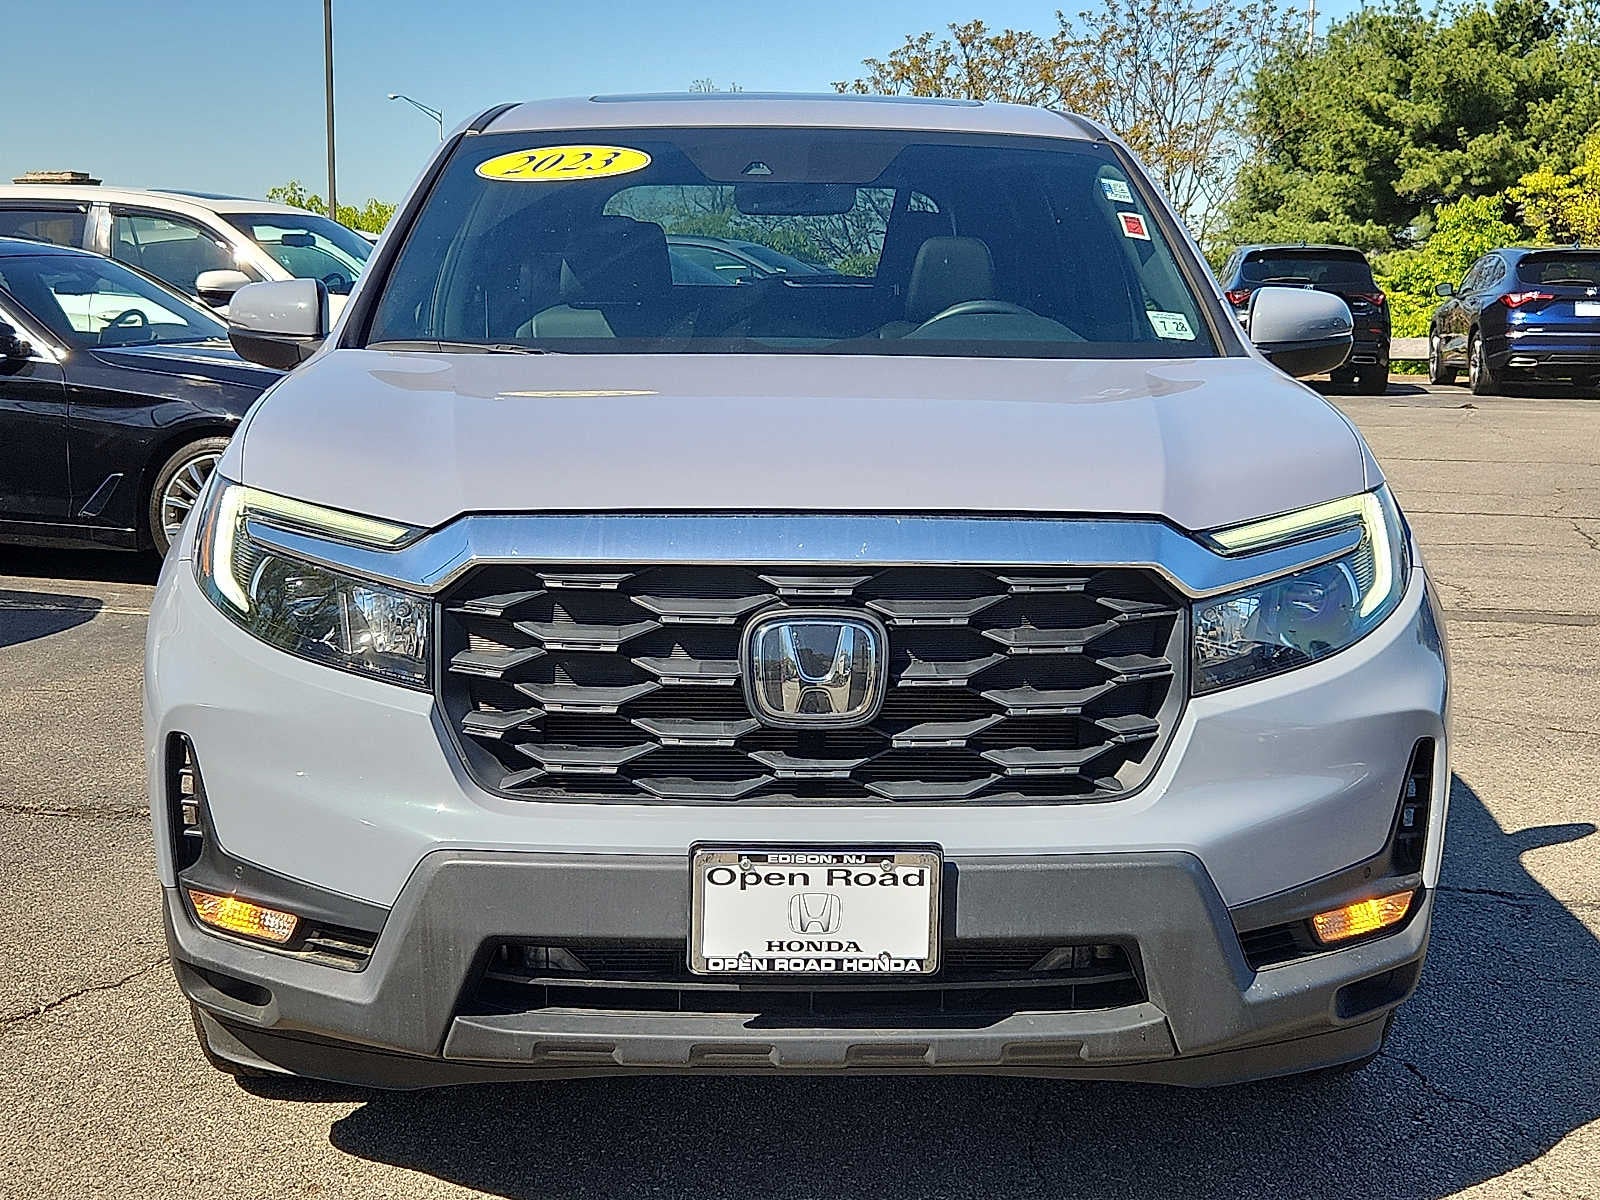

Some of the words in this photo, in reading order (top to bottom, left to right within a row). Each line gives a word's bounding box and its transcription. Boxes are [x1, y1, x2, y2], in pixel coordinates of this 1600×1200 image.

[501, 151, 621, 175] 2023
[1159, 320, 1168, 332] 7
[1172, 321, 1188, 332] 28
[767, 854, 838, 864] EDISON,
[843, 854, 866, 864] NJ
[706, 867, 810, 890] Open
[826, 868, 925, 887] Road
[765, 940, 864, 953] HONDA
[708, 958, 768, 972] OPEN
[774, 958, 838, 972] ROAD
[843, 958, 922, 972] HONDA
